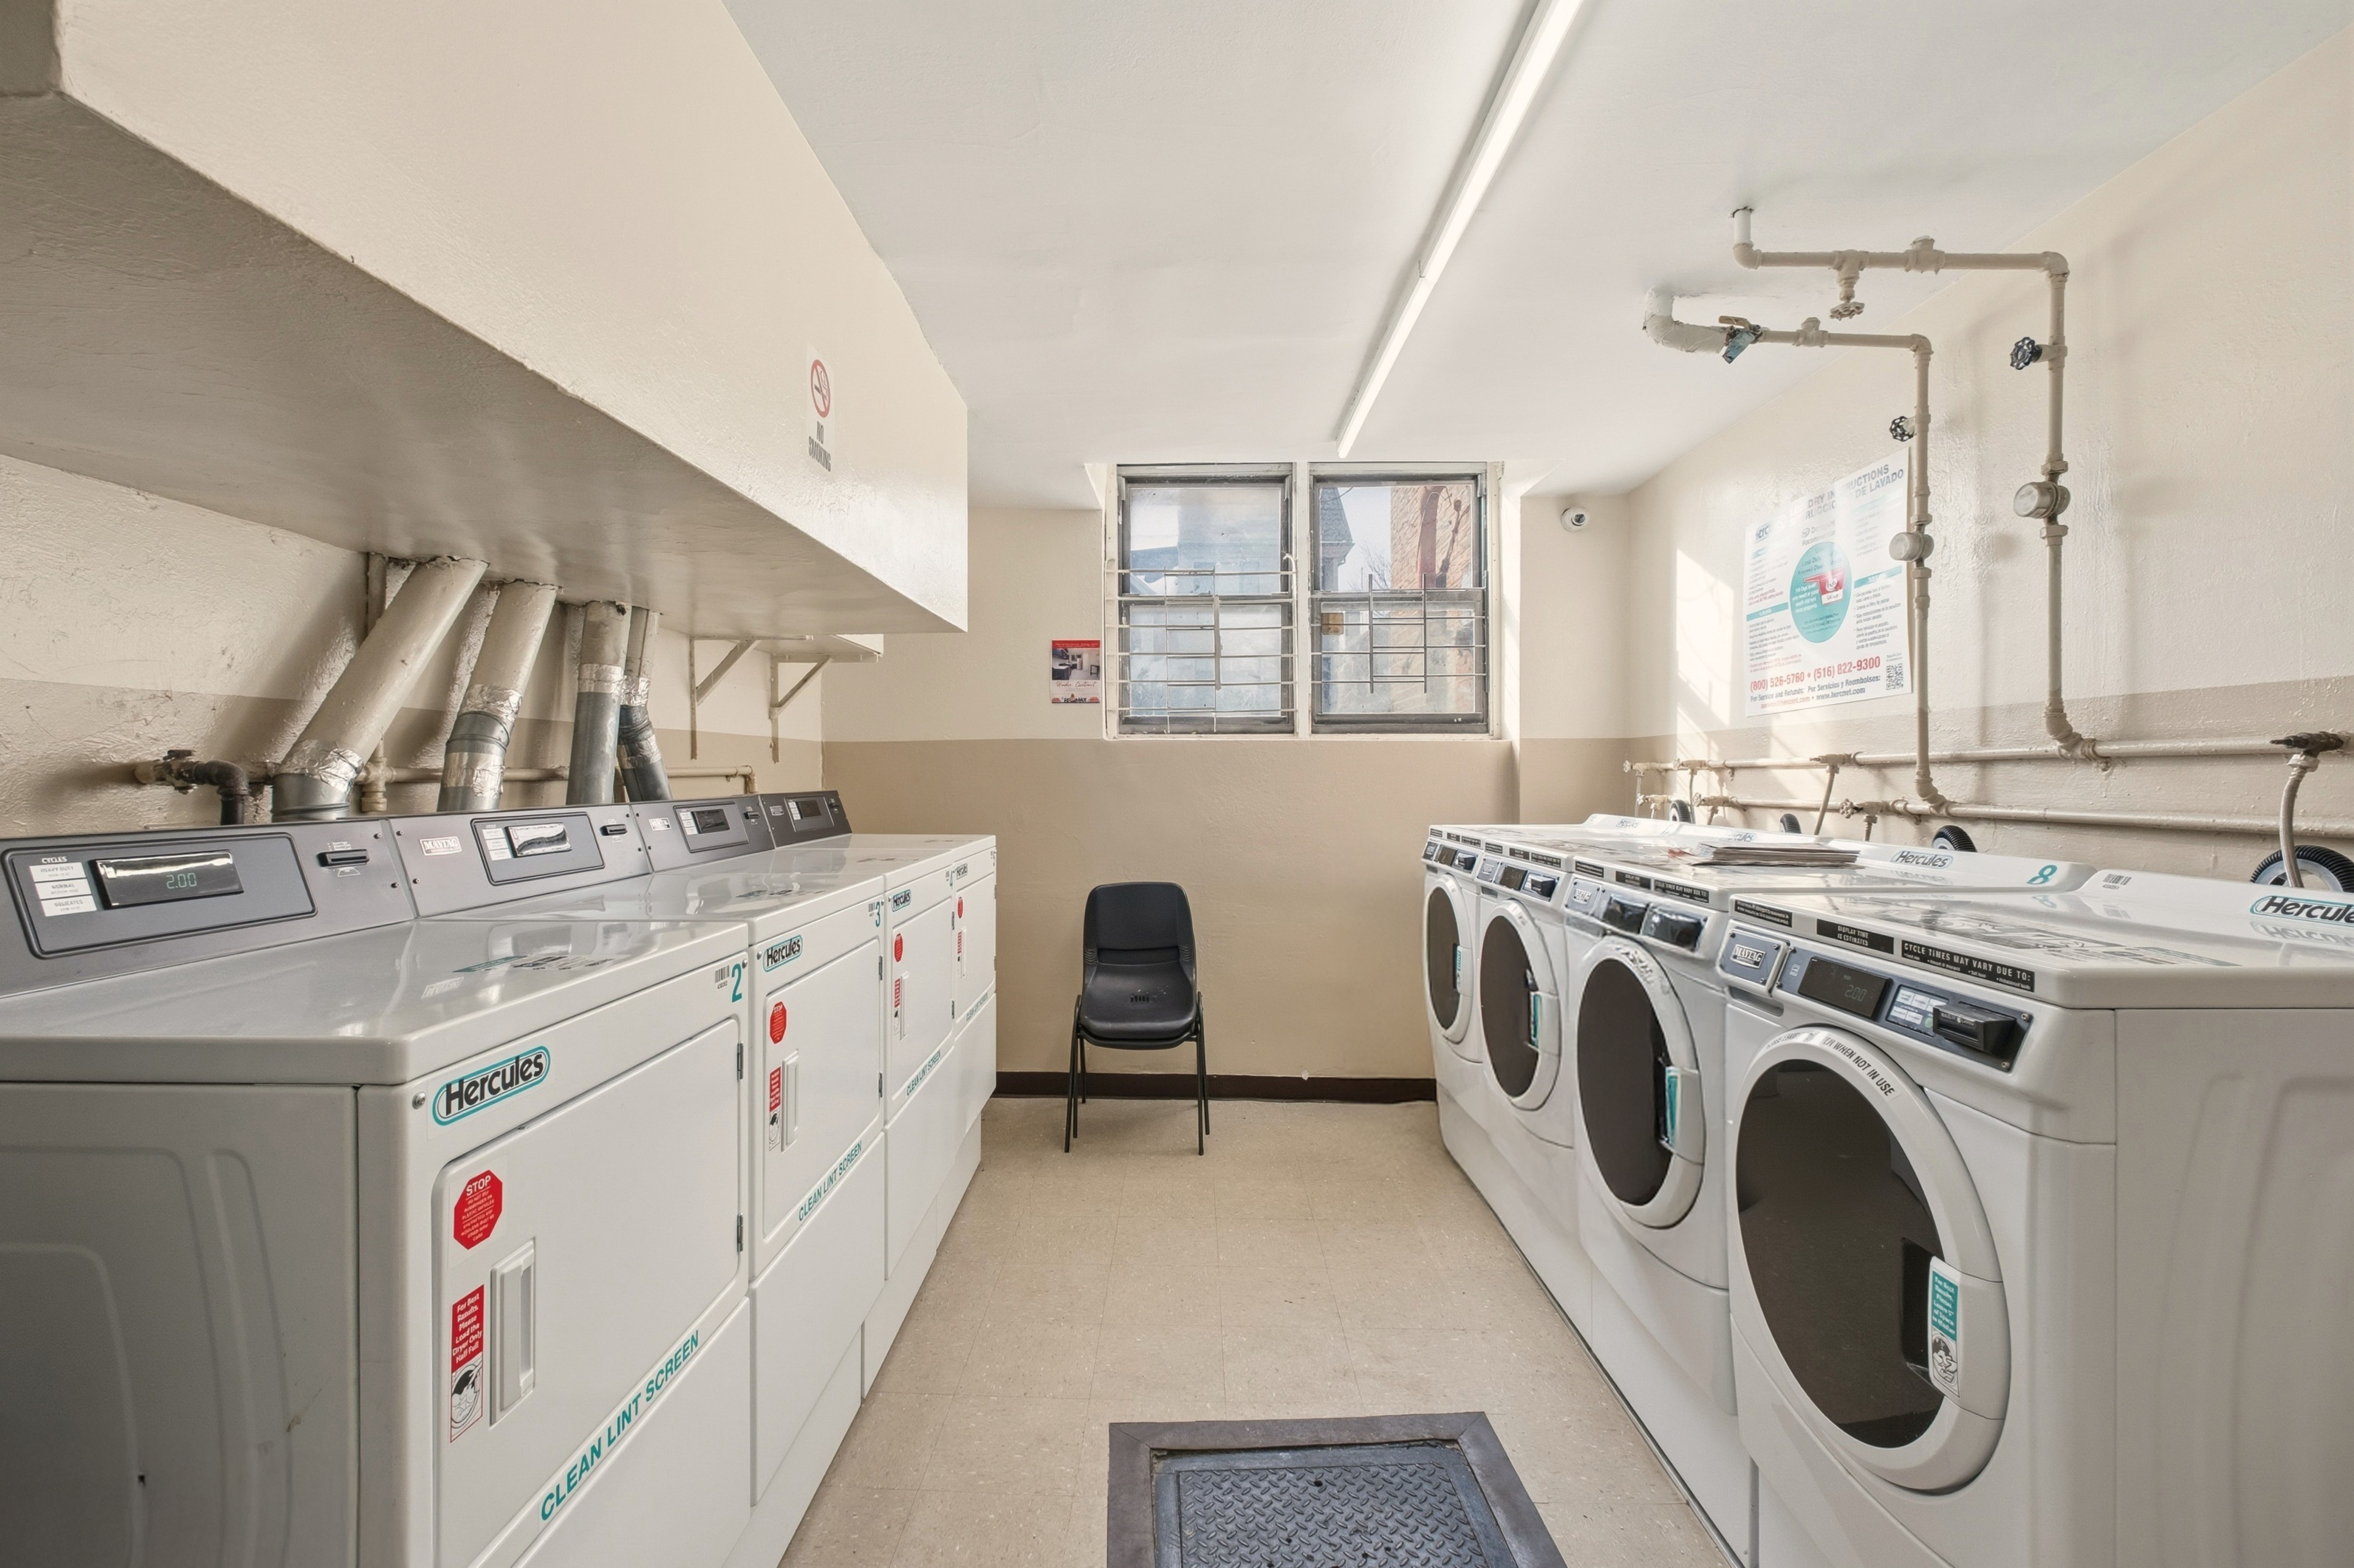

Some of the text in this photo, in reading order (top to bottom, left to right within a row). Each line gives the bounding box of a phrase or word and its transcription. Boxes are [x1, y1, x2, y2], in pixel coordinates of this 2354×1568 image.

[817, 421, 824, 444] NO
[809, 436, 831, 472] SMOKING
[1856, 469, 1904, 498] DE LAVADO
[1750, 679, 1767, 692] (800)
[1814, 666, 1834, 681] (516)
[1837, 656, 1880, 675] 822-9300
[1896, 851, 1948, 867] Hercules
[166, 873, 197, 889] 2.00
[2026, 865, 2058, 884] 8
[767, 939, 800, 967] Hercules
[1736, 945, 1764, 962] MAYTAG
[1904, 943, 2031, 981] CYCLE TIMES MAY VARY DUE TO:
[732, 963, 742, 1003] 2
[1832, 1042, 1895, 1096] WHEN NOT IN USE
[446, 1054, 543, 1116] Hercules
[466, 1175, 491, 1196] STOP
[799, 1140, 862, 1221] CLEAN LINT SCREEN
[457, 1293, 479, 1313] For Best
[456, 1330, 470, 1344] Load
[459, 1315, 477, 1332] Please
[453, 1330, 482, 1357] Dryer Only
[541, 1329, 698, 1521] CLEAN LINT SCREEN
